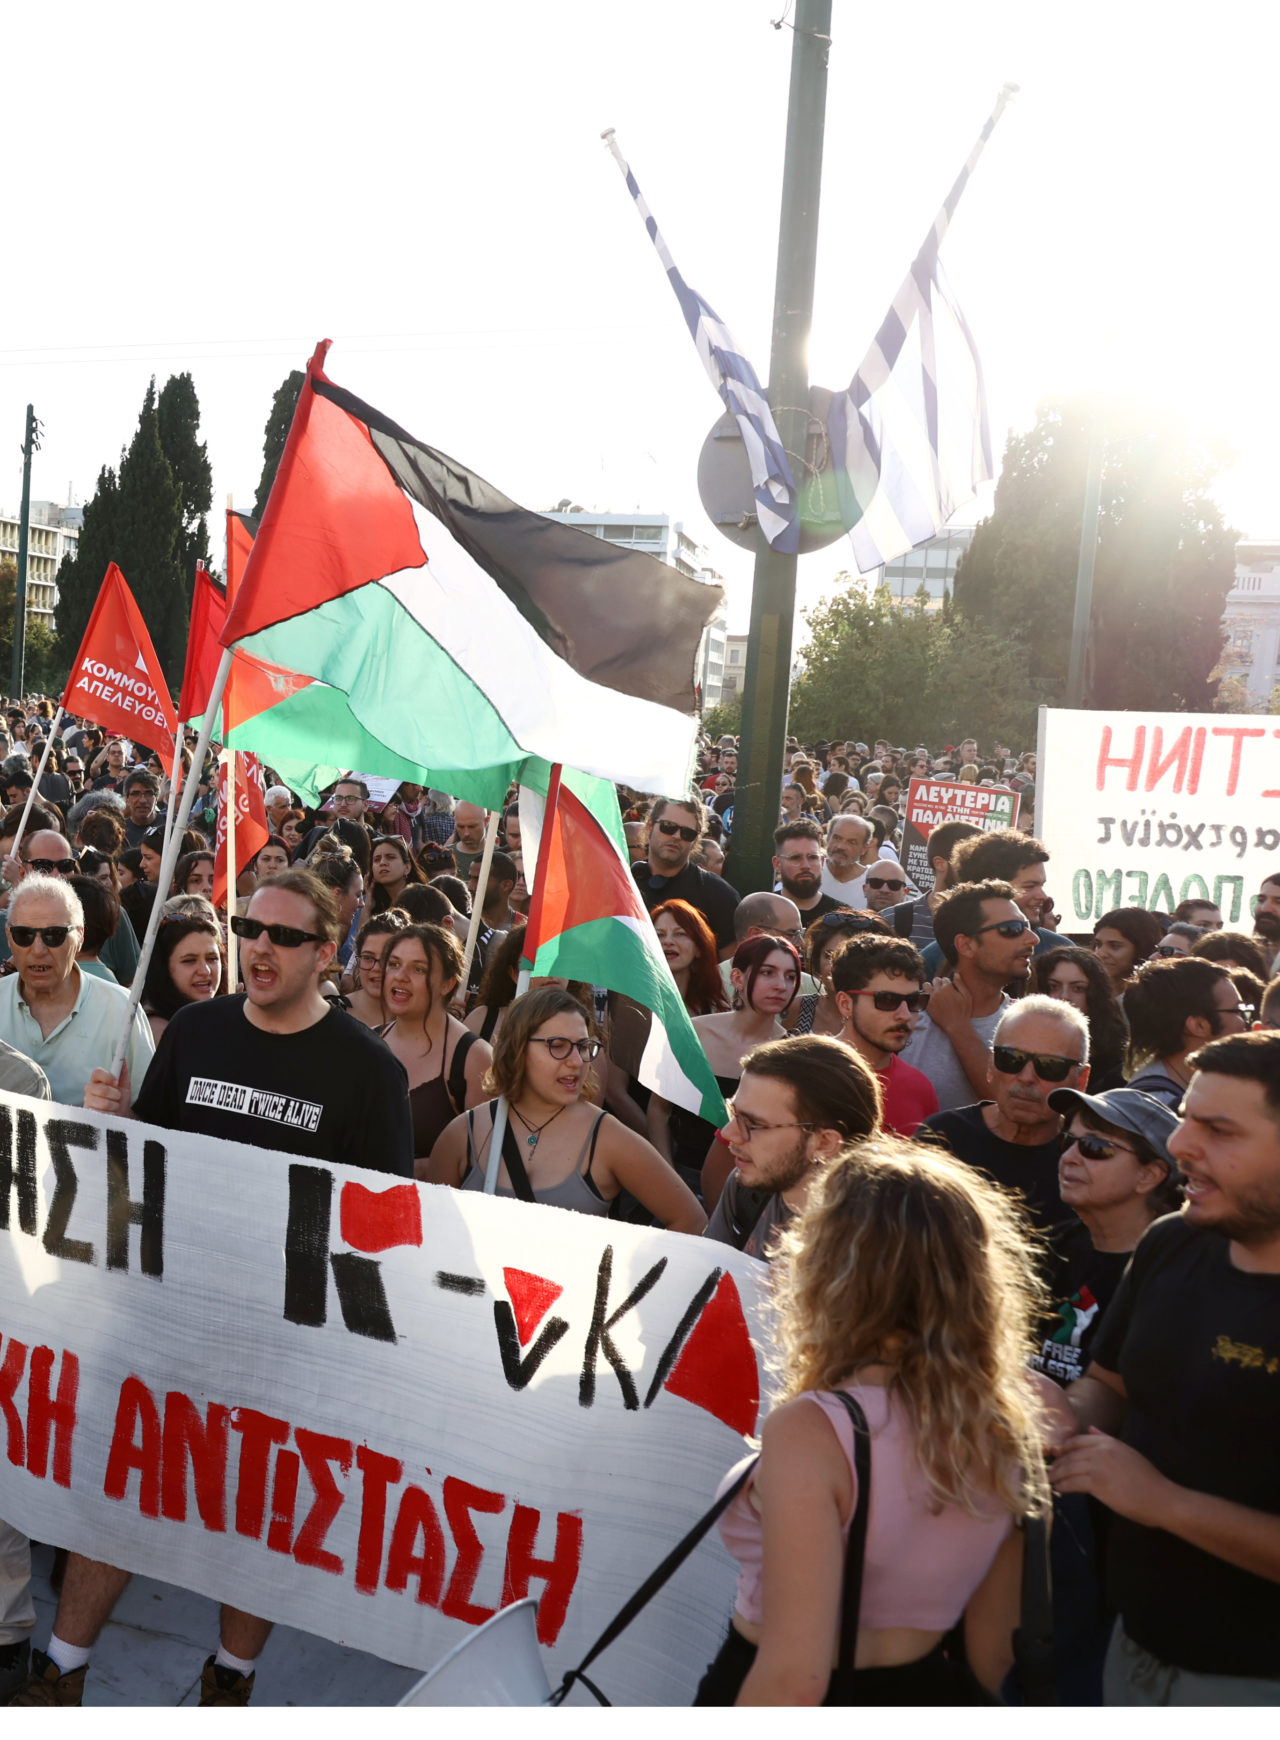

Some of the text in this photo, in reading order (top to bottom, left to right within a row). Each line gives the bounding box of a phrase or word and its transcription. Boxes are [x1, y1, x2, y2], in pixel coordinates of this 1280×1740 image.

[914, 785, 1010, 813] ΛΕΥΤΕΡΙΑ
[189, 1080, 320, 1130] ONCE DEAD TWICE ALIVE
[1041, 1338, 1082, 1364] FREE
[103, 1373, 583, 1648] ΑΝΤΙΣΤΑΣΗ
